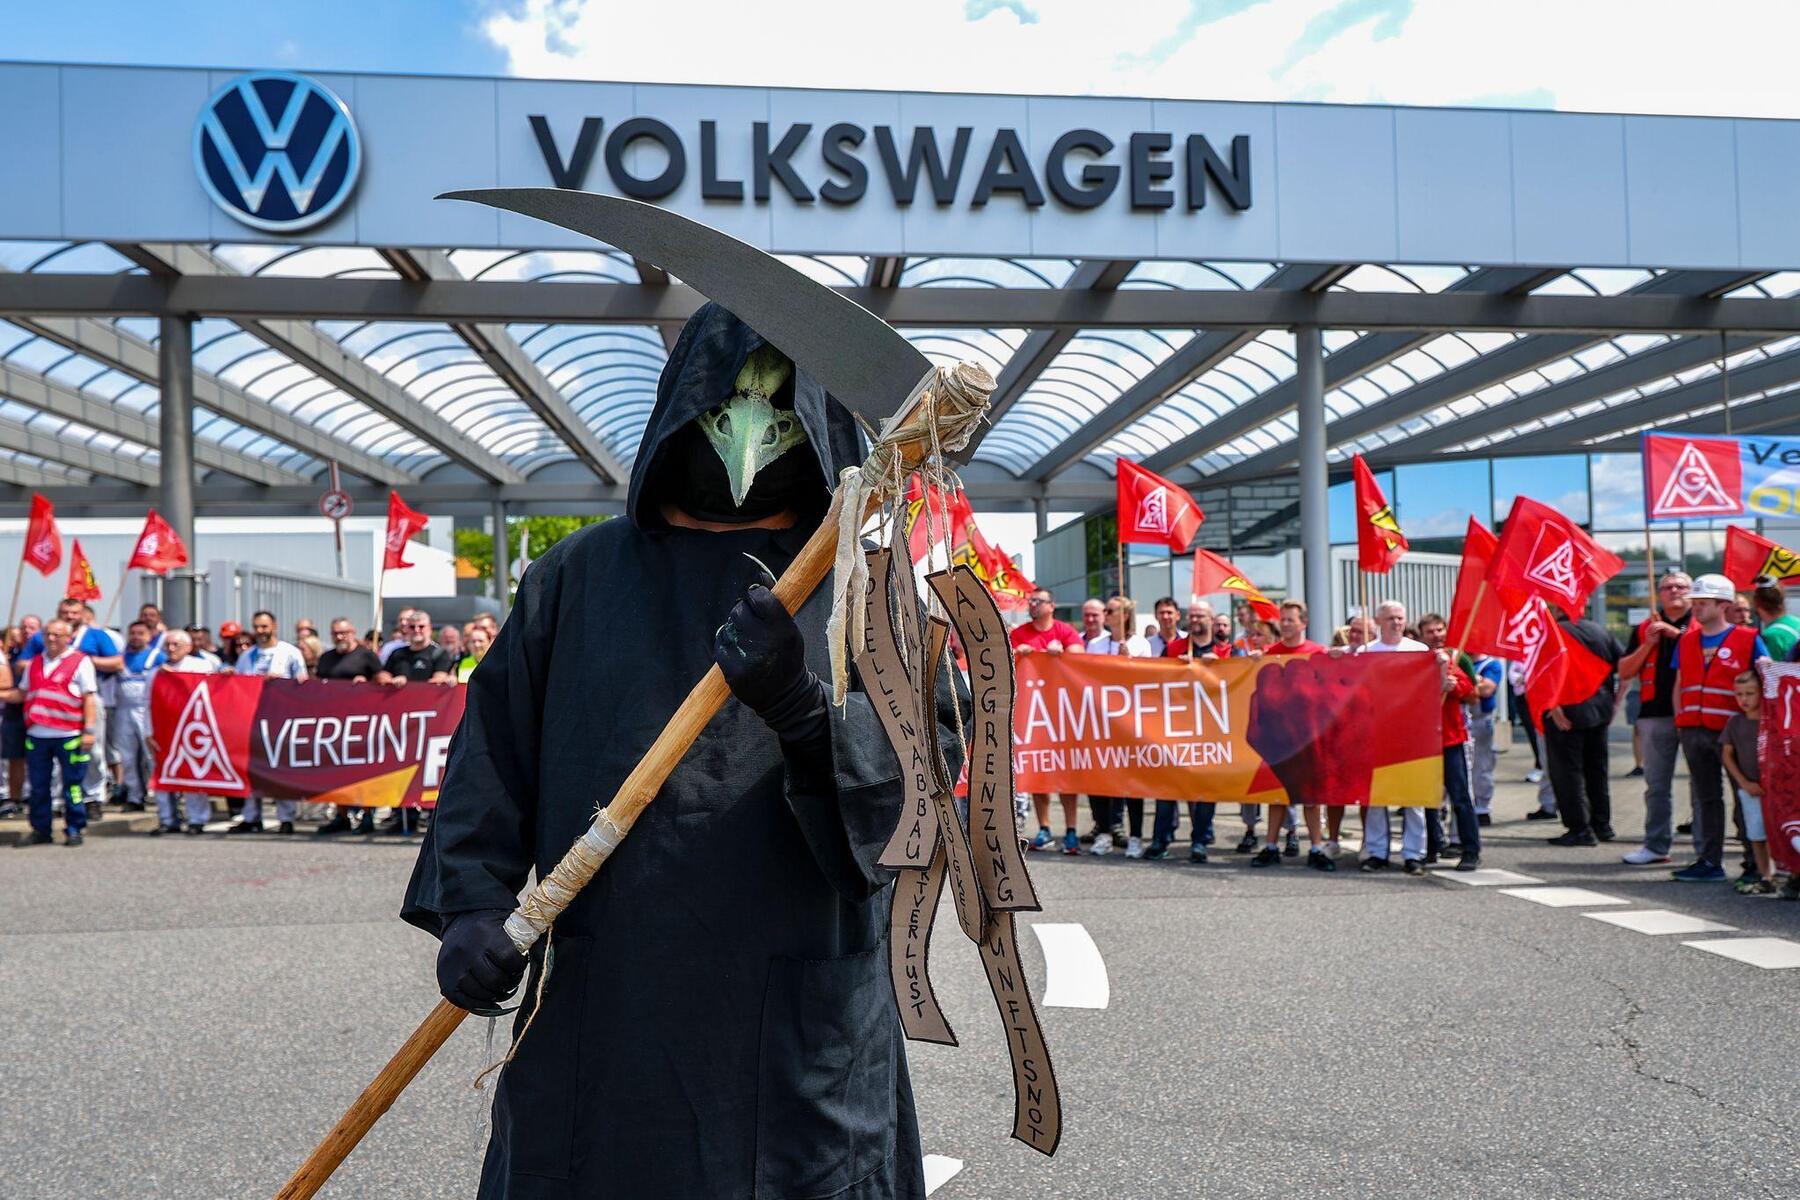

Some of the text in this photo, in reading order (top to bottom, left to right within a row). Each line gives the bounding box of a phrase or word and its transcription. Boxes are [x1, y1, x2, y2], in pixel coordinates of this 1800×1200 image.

[528, 114, 1252, 212] VOLKSWAGEN
[1748, 488, 1800, 516] O
[260, 710, 437, 769] VEREINT
[954, 584, 1014, 903] AUSGRENZUNG
[1070, 747, 1093, 770] IM
[1094, 740, 1233, 769] VW-KONZERN
